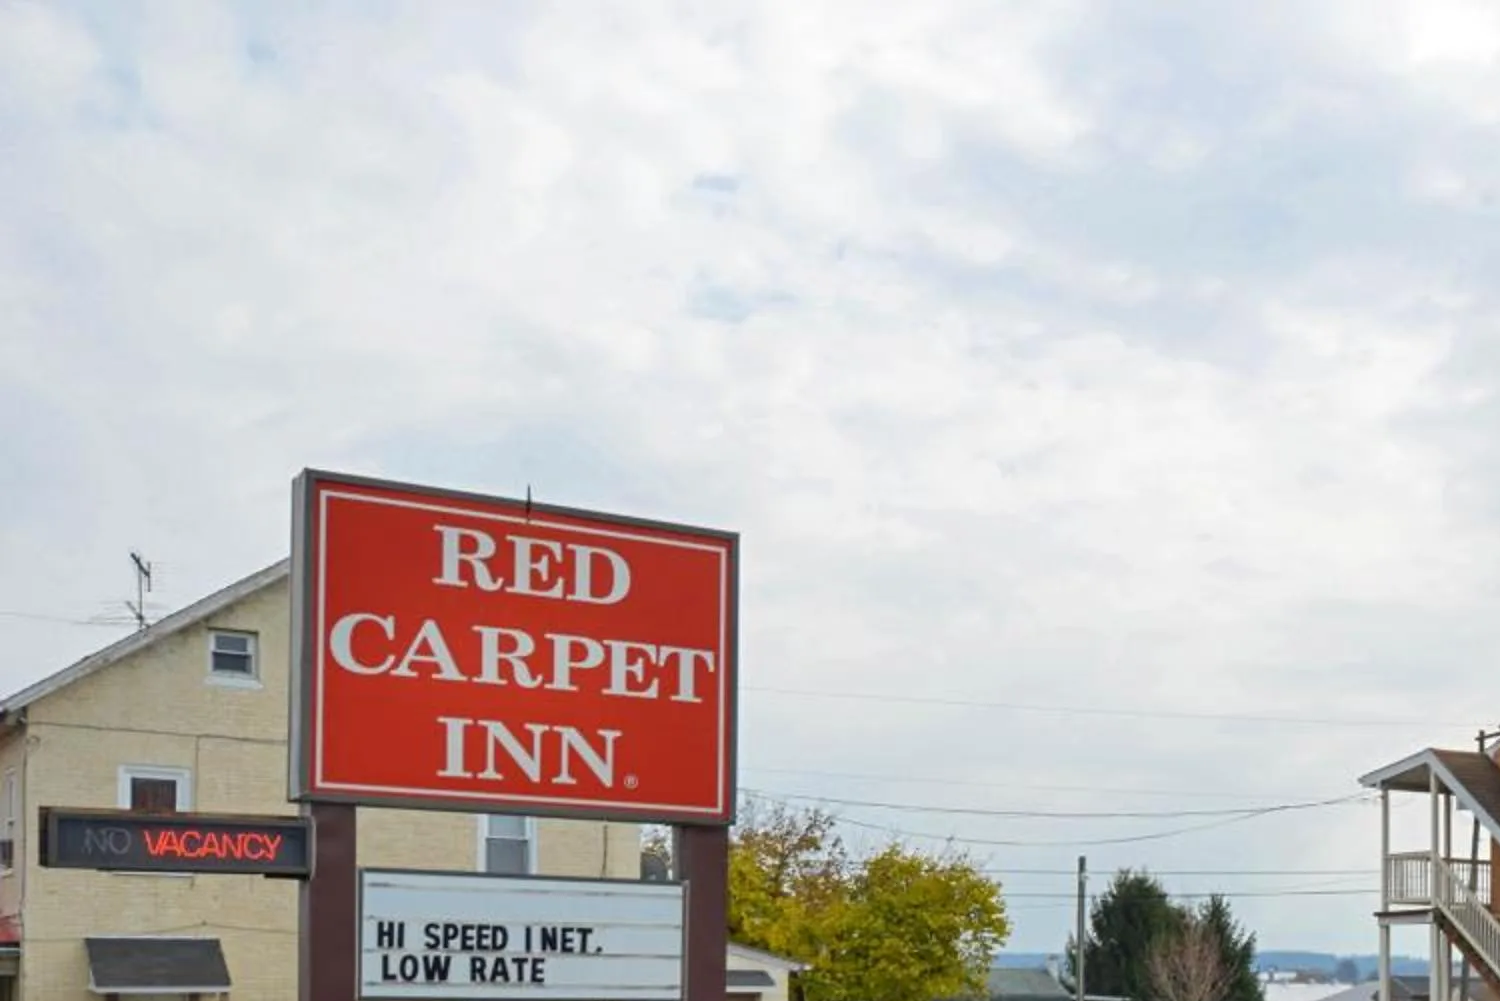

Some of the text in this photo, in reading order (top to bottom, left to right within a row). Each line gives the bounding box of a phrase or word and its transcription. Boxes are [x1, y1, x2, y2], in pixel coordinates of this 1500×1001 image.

[432, 524, 631, 605] RED
[329, 612, 715, 703] CARPET
[437, 716, 622, 788] INN
[83, 827, 283, 861] NO VACANCY
[376, 921, 405, 950] HI
[424, 923, 509, 952] SPEED
[381, 954, 545, 983] LOW RATE
